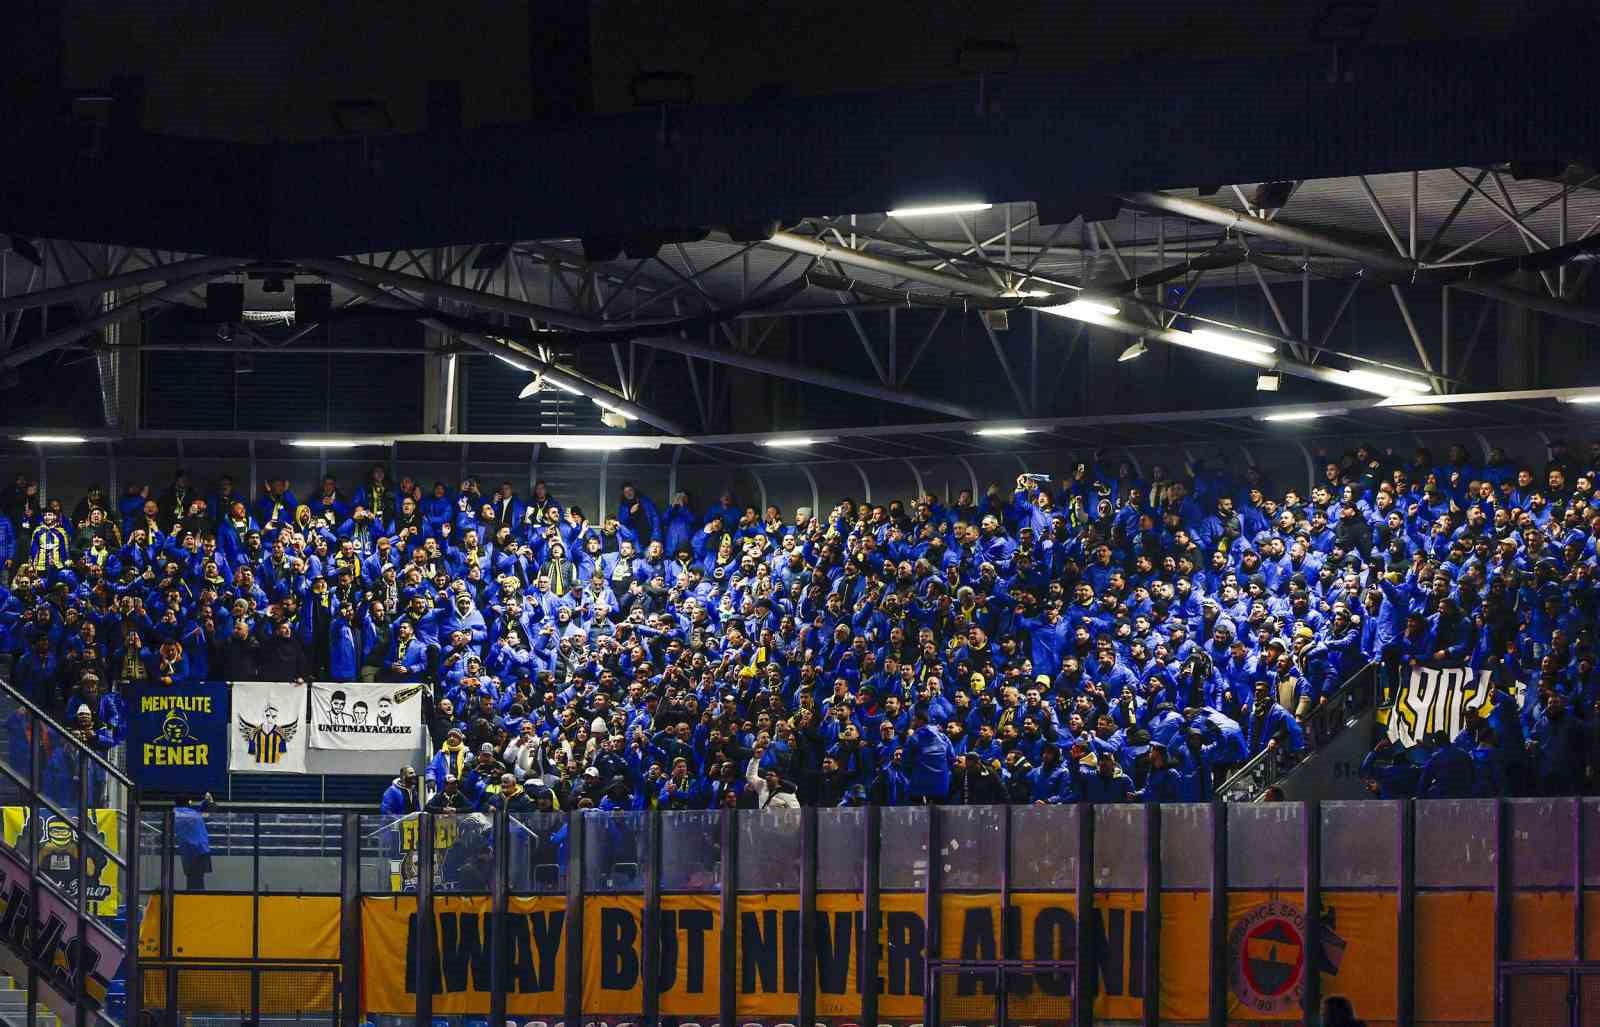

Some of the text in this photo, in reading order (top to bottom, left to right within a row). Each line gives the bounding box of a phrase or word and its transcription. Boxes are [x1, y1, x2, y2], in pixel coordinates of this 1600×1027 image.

[141, 695, 212, 713] MENTALITE
[143, 743, 209, 765] FENER
[405, 911, 568, 993] AWAY
[600, 908, 713, 993] BUT
